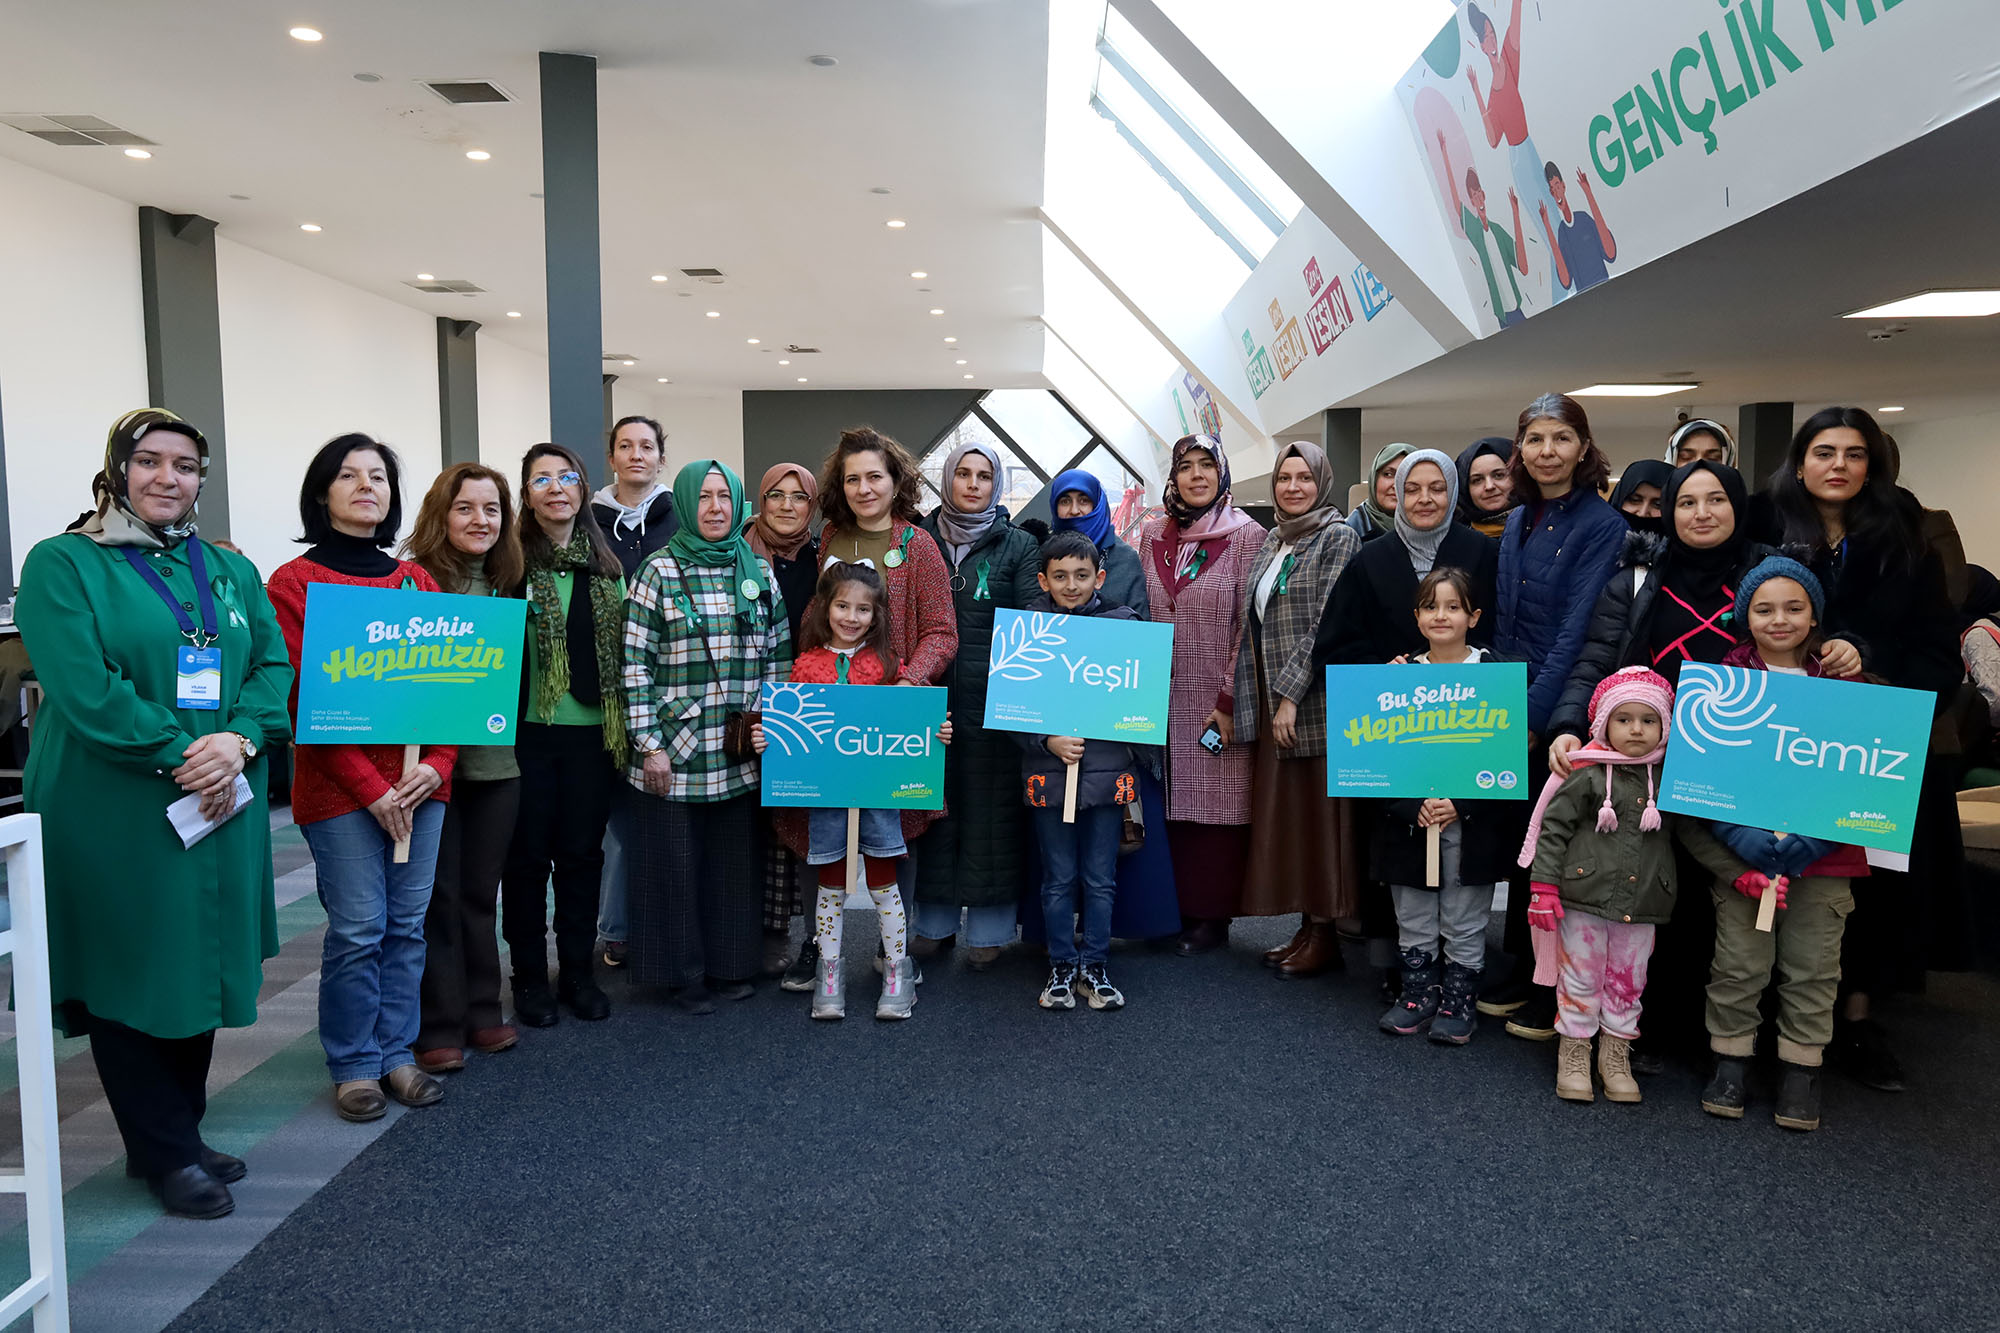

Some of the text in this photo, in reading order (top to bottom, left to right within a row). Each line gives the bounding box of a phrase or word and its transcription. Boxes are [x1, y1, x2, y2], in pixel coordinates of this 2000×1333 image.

[1588, 0, 1803, 187] GENÇLİK
[365, 616, 475, 645] Bu Şehir
[322, 637, 505, 683] Hepimizin
[1060, 653, 1140, 692] Yeşil
[1377, 683, 1477, 712] Bu Şehir
[834, 725, 931, 757] Güzel
[1344, 701, 1511, 747] Hepimizin
[1767, 723, 1910, 781] Temiz
